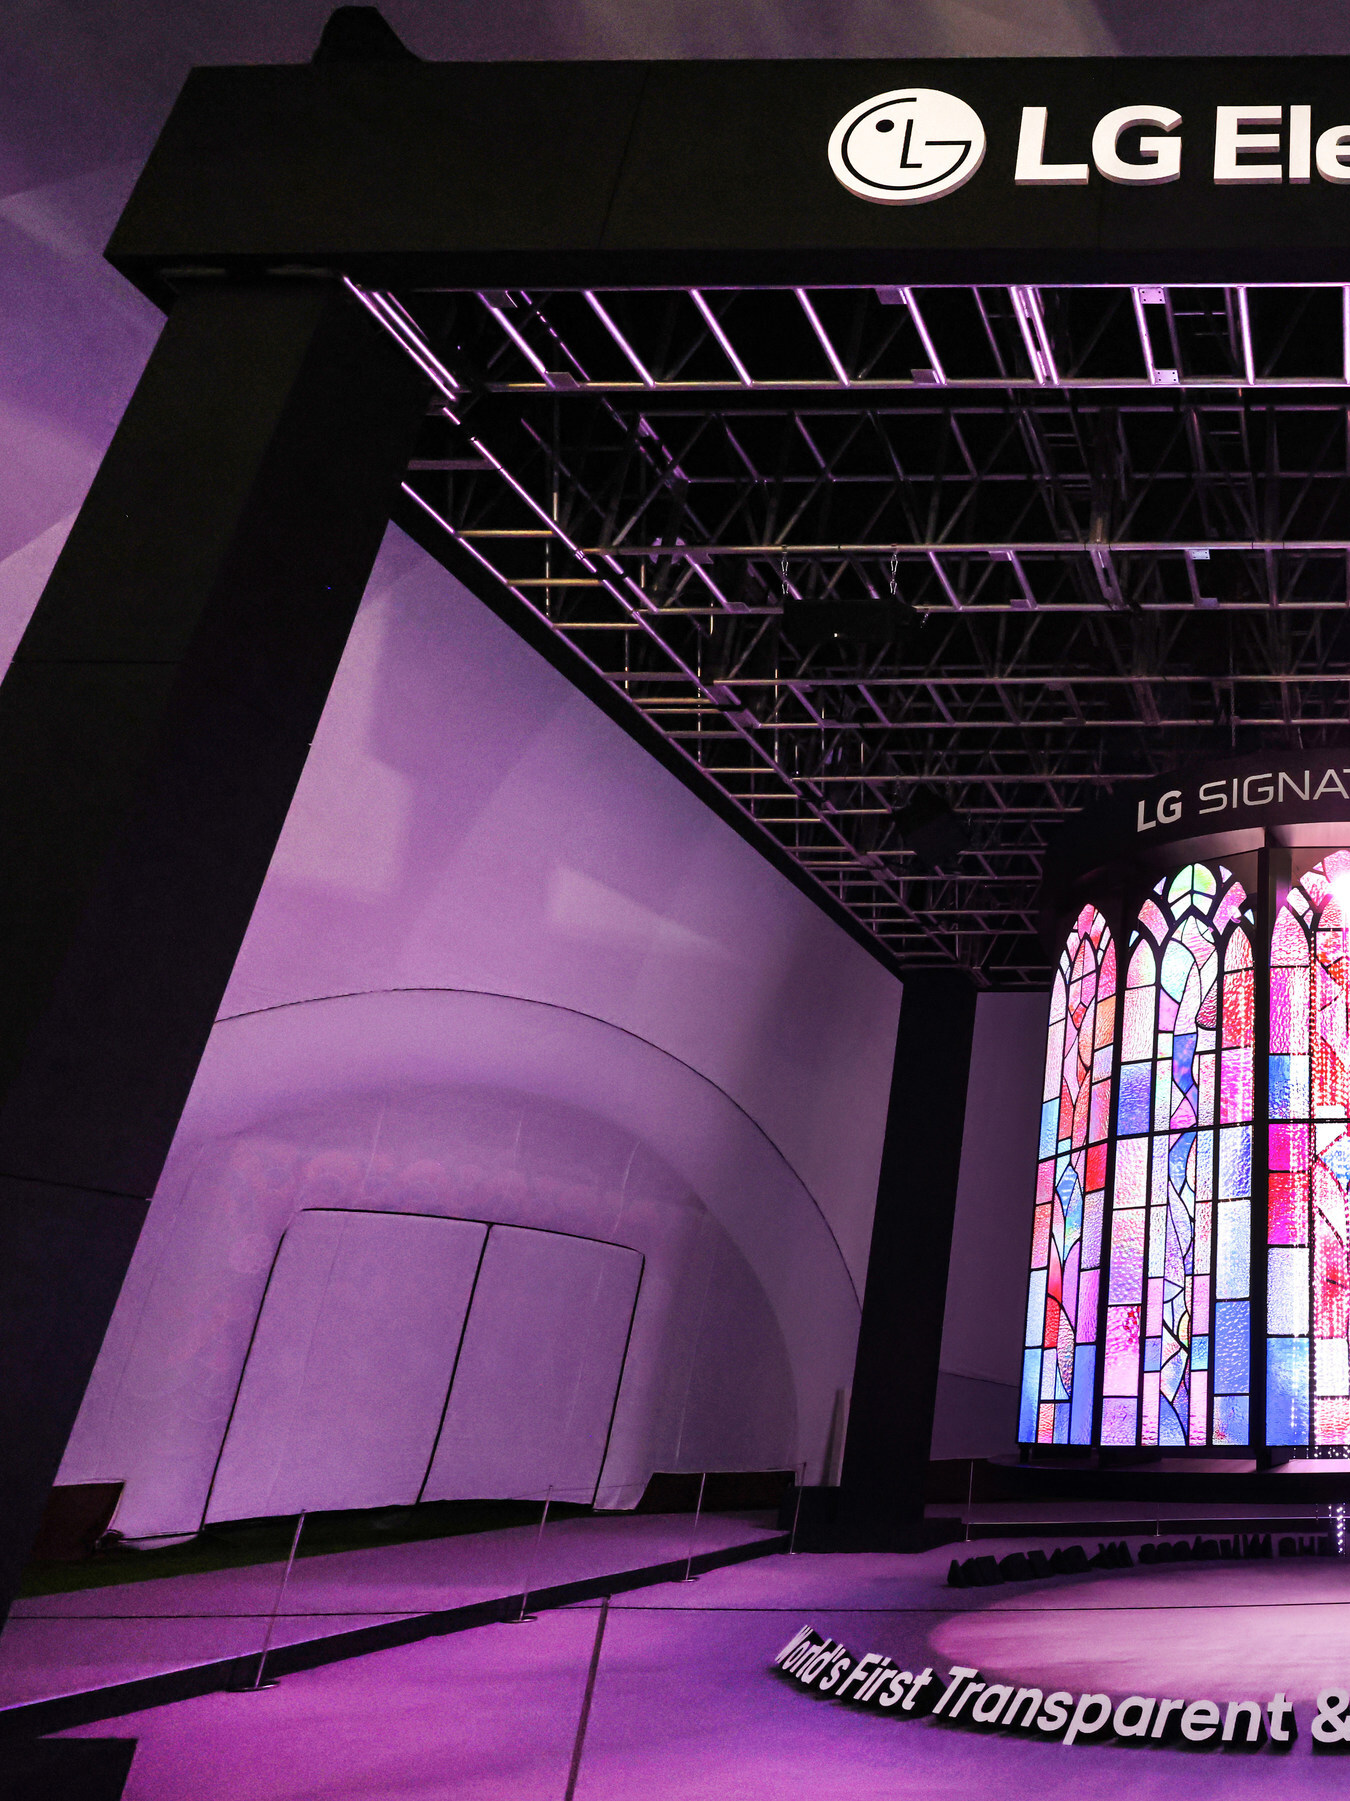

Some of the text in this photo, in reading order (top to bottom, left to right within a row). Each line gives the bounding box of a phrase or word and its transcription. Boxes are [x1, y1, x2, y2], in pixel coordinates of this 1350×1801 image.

[1014, 105, 1183, 184] LG
[1136, 790, 1182, 832] LG
[775, 1625, 848, 1691] World's
[842, 1653, 933, 1709] First
[933, 1666, 1293, 1745] Transparent
